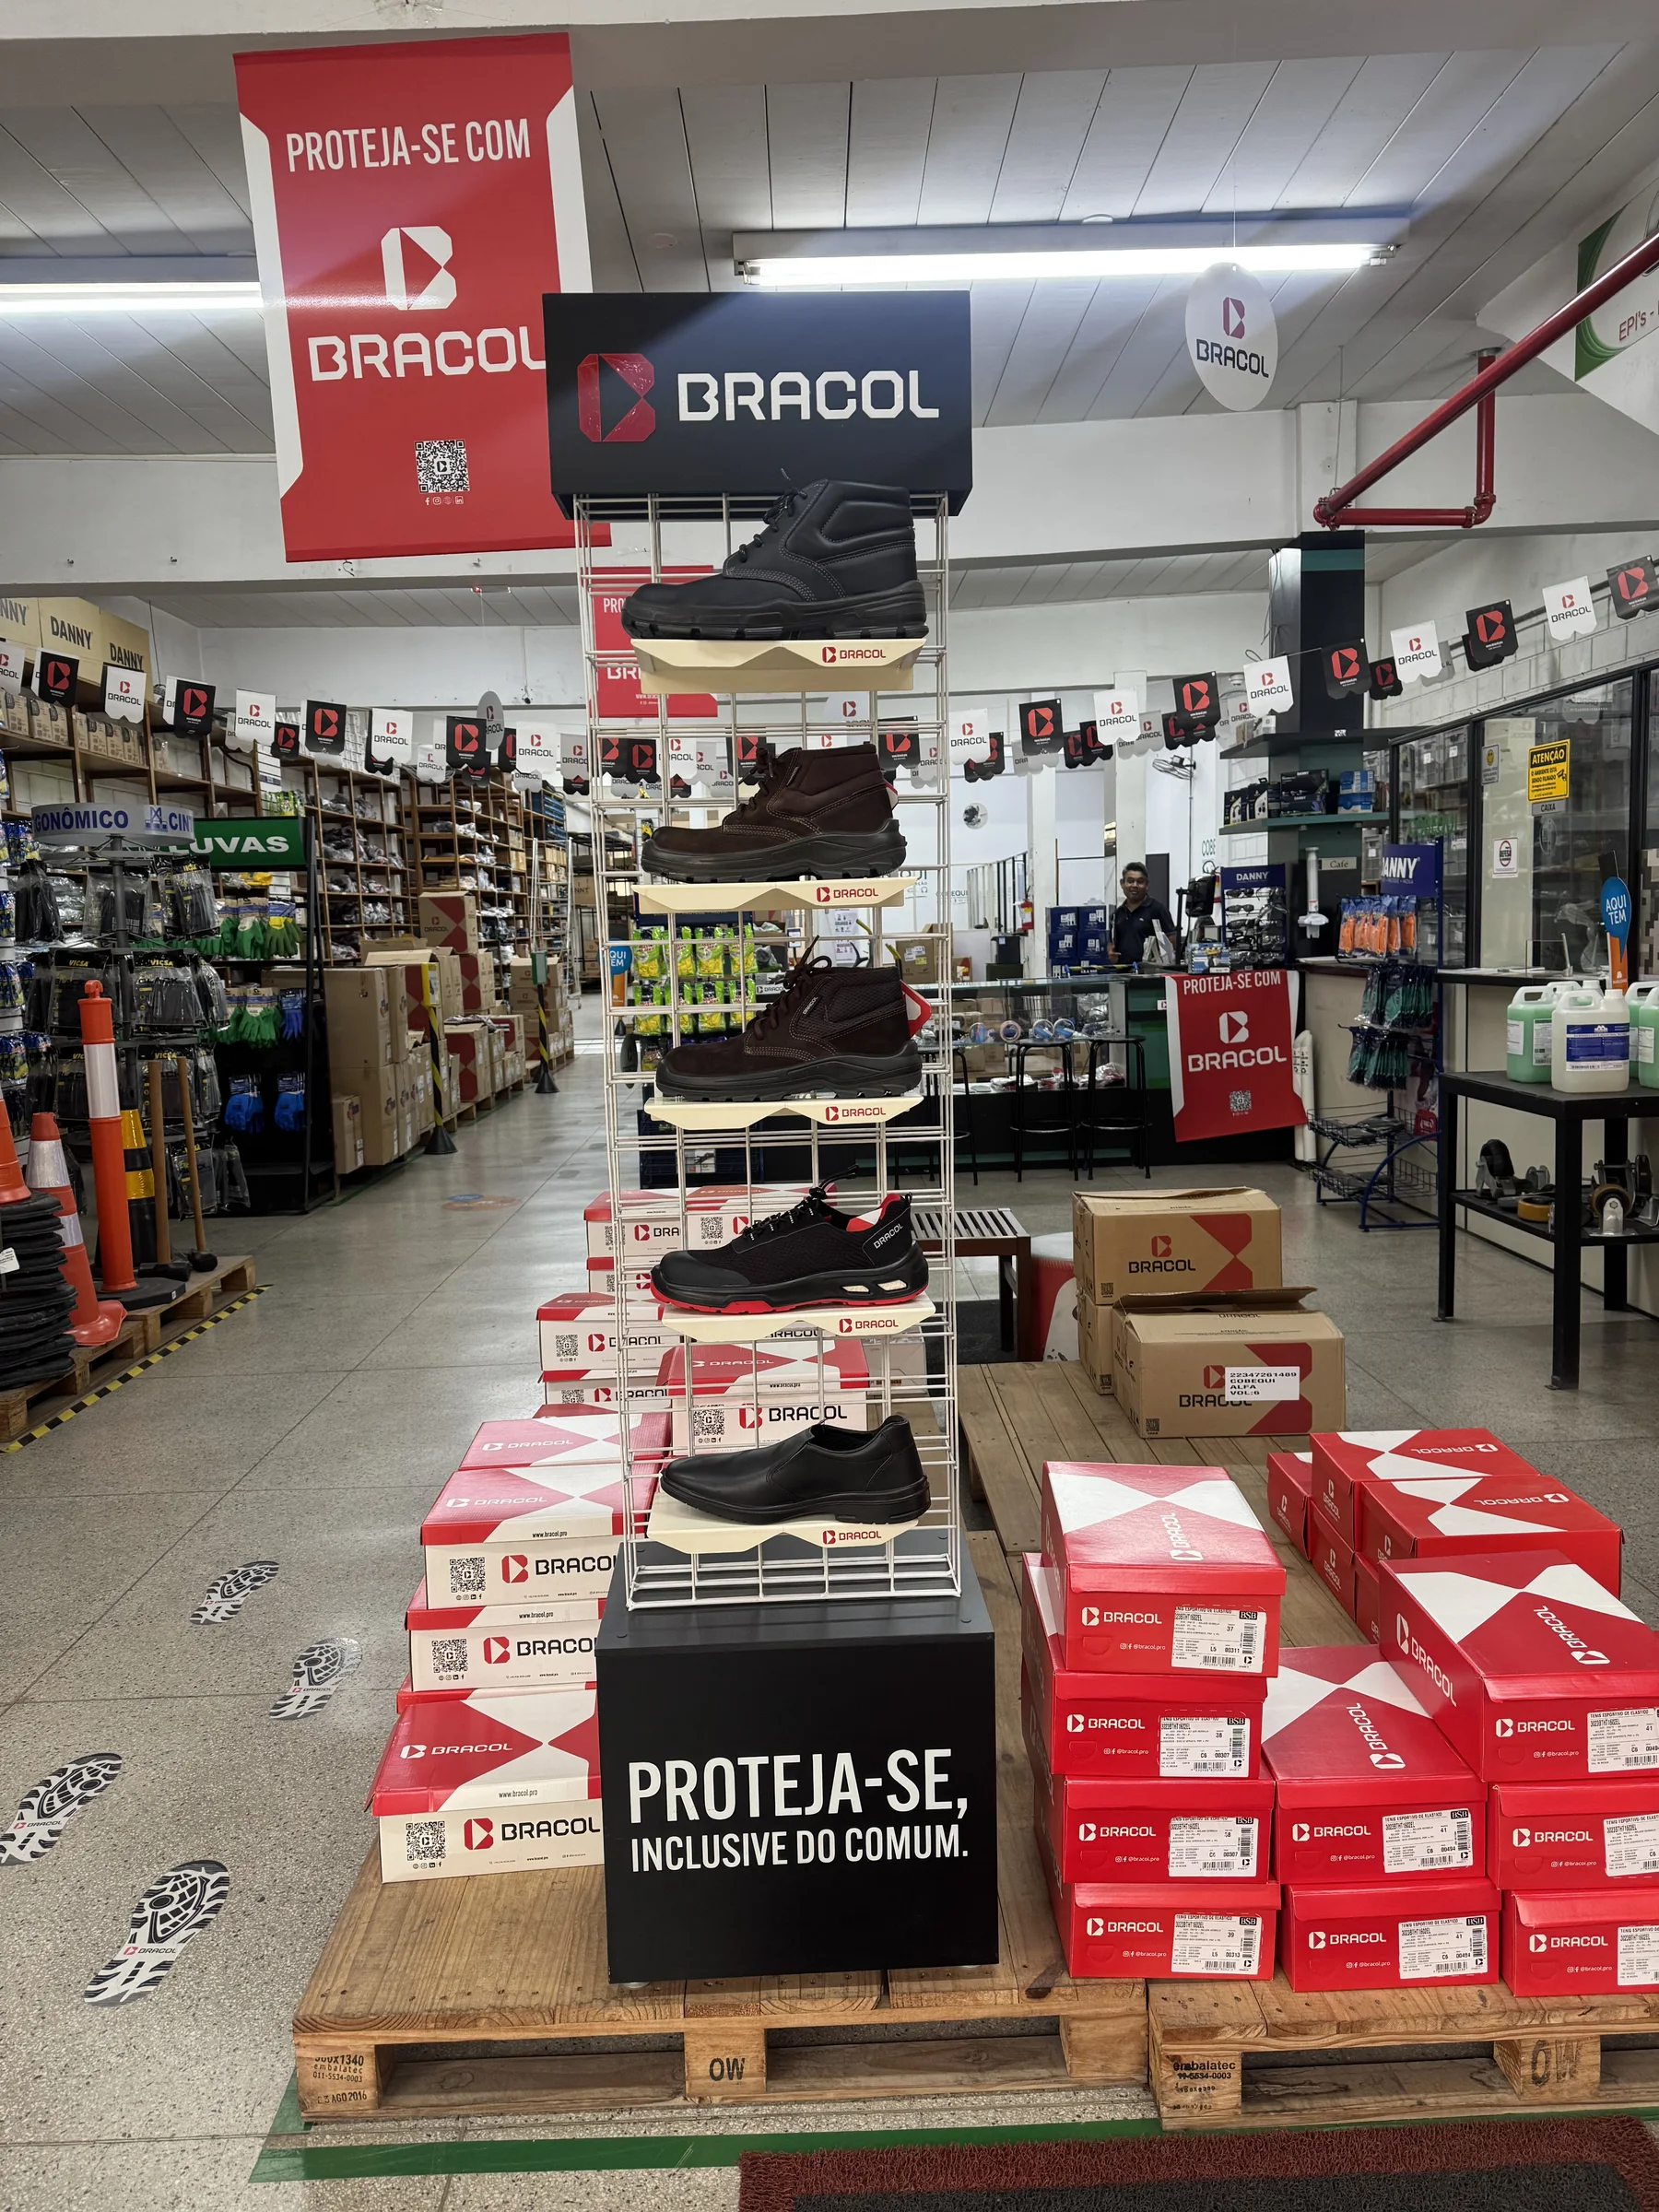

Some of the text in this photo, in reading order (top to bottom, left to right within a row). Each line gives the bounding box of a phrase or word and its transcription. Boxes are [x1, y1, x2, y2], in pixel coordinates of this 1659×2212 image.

[286, 118, 531, 172] PROTEJA-SE COM
[1618, 311, 1646, 342] EPI's
[308, 326, 546, 381] BRACOL
[1196, 338, 1269, 378] BRACOL
[677, 371, 939, 421] BRACOL
[0, 599, 28, 626] NNY
[1551, 606, 1592, 623] BRACOL
[50, 616, 92, 650] DANNY
[110, 642, 143, 671] DANNY
[840, 649, 886, 660] BRACOL
[1399, 651, 1437, 665] BRACOL
[0, 667, 19, 680] ACOL
[1251, 685, 1288, 699] BRACOL
[108, 692, 141, 706] BRACOL
[238, 717, 272, 728] BRACOL
[1100, 715, 1137, 726] BRACOL
[374, 735, 409, 746] BRACOL
[950, 736, 987, 747] BRACOL
[519, 747, 554, 758] BRACOL
[1532, 748, 1564, 764] ATENÇÃO
[562, 757, 588, 765] BRACO
[1541, 803, 1556, 812] CAIXA
[35, 806, 129, 831] GONÔMICO
[1330, 860, 1348, 868] Café
[1382, 857, 1418, 879] ANNY
[1236, 871, 1269, 881] DANNY
[833, 888, 878, 899] BRACOL
[1606, 894, 1627, 912] AQUI
[1608, 912, 1627, 924] TEM
[606, 949, 627, 960] QUI
[1183, 971, 1281, 994] PROTEJA-SE COM
[803, 996, 818, 1015] BRACOL
[1188, 1046, 1287, 1072] BRACOL
[842, 1107, 886, 1117] BRACOL
[653, 1227, 679, 1237] BRA
[873, 1223, 904, 1249] BRACOL
[1128, 1259, 1197, 1274] BRACOL
[855, 1319, 899, 1329] BRACOL
[769, 1406, 847, 1421] BRACOL
[508, 1440, 573, 1449] BRACOL
[474, 1496, 547, 1506] BRACOL
[1474, 1497, 1544, 1506] BRACOL
[532, 1530, 568, 1539] www.bracol.pro
[839, 1530, 881, 1541] BRACOL
[1161, 1512, 1190, 1548] BRACOL
[519, 1611, 554, 1619] www.bracol.pro
[1104, 1611, 1162, 1624] BRACOL
[1534, 1605, 1588, 1650] BRACOL
[1411, 1636, 1457, 1708] BRACOL
[1088, 1718, 1146, 1730] BRACOL
[1346, 1703, 1388, 1749] BRACOL
[1517, 1719, 1575, 1733] BRACOL
[431, 1742, 512, 1755] BRACOL
[629, 1748, 968, 1823] PROTEJA-SE,
[499, 1789, 537, 1798] www.bracol.pro
[1452, 1810, 1468, 1818] BSB
[501, 1817, 600, 1841] BRACOL
[1100, 1826, 1156, 1837] BRACOL
[1313, 1825, 1371, 1837] BRACOL
[1535, 1829, 1594, 1842] BRACOL
[631, 1824, 968, 1872] INCLUSIVE DO COMUM.
[1108, 1922, 1163, 1933] BRACOL
[1467, 1917, 1483, 1925] BSB
[1330, 1933, 1386, 1945] BRACOL
[1550, 1935, 1608, 1948] BRACOL
[313, 2064, 362, 2074] embalatec
[709, 2058, 746, 2081] OW
[1173, 2061, 1236, 2071] embalatec
[313, 2072, 362, 2082] 011-5534-0003
[332, 2090, 367, 2103] AGO 2016
